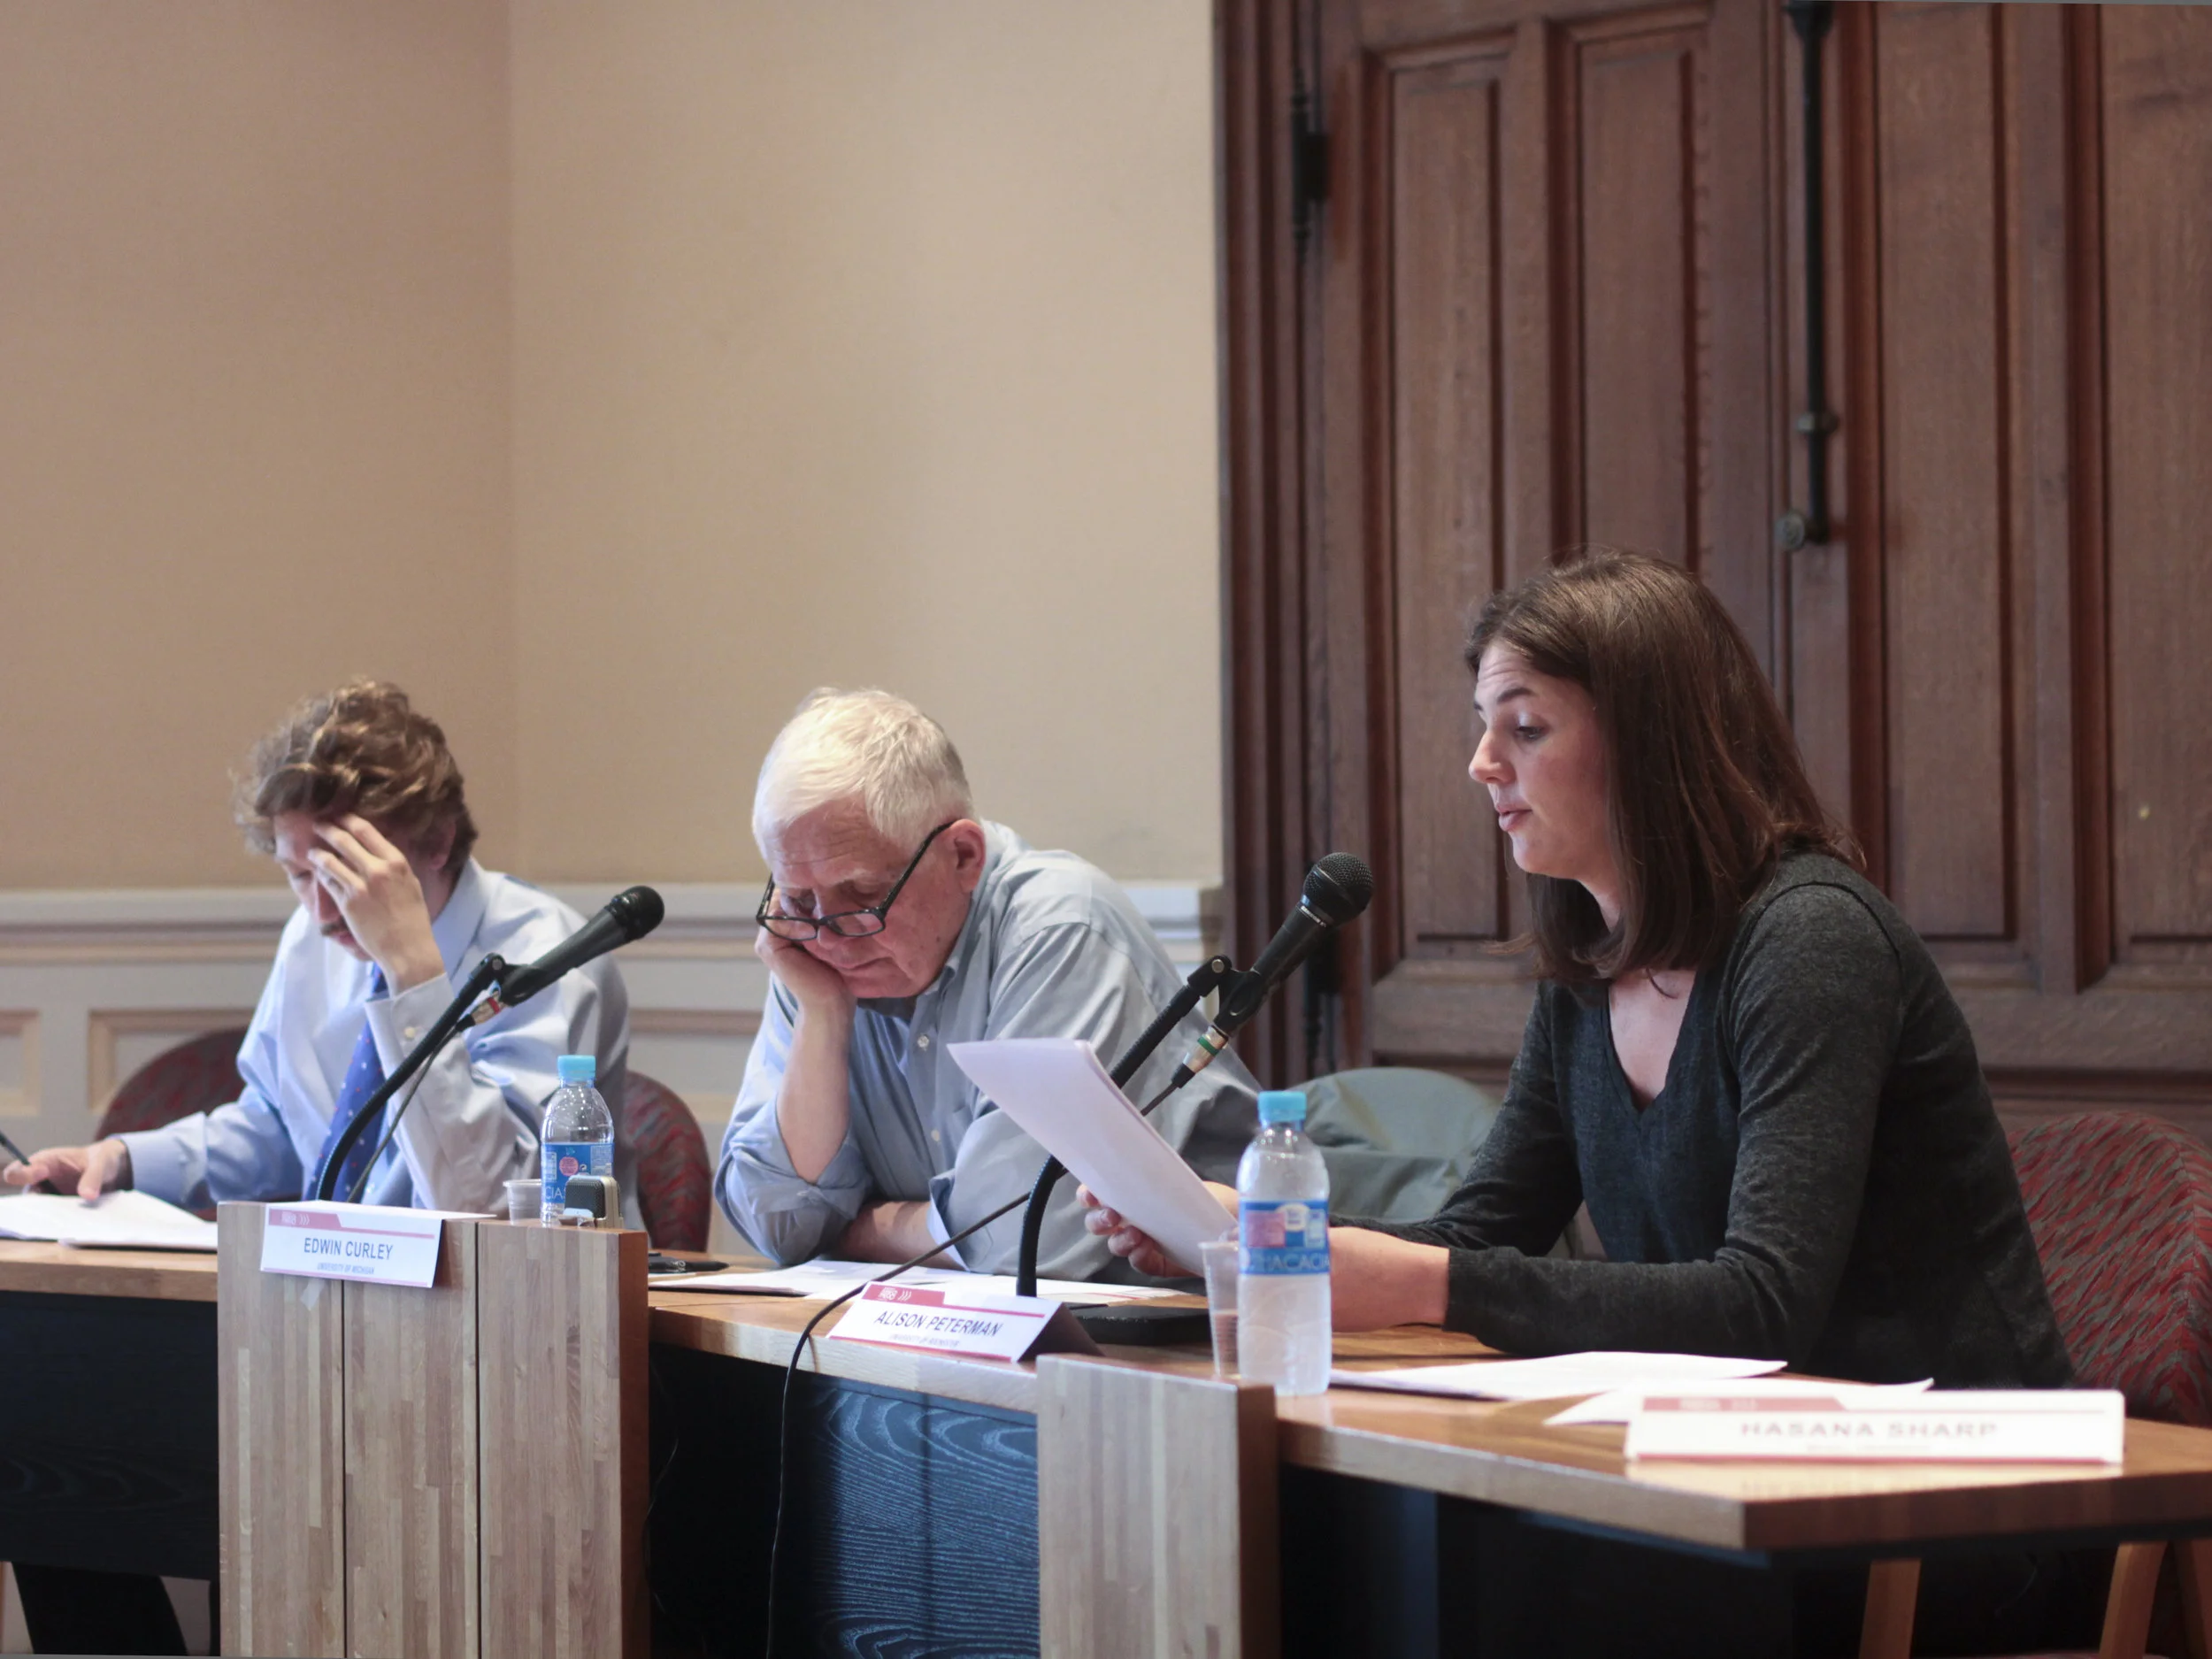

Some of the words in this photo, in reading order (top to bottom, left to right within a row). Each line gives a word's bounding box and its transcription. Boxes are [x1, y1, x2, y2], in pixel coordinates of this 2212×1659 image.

[303, 1237, 342, 1256] EDWIN
[346, 1240, 393, 1260] CURLEY
[874, 1310, 927, 1328] ALISON
[926, 1316, 1003, 1337] PETERMAN
[1741, 1421, 1874, 1438] HASANA
[1888, 1421, 1998, 1438] SHARP
